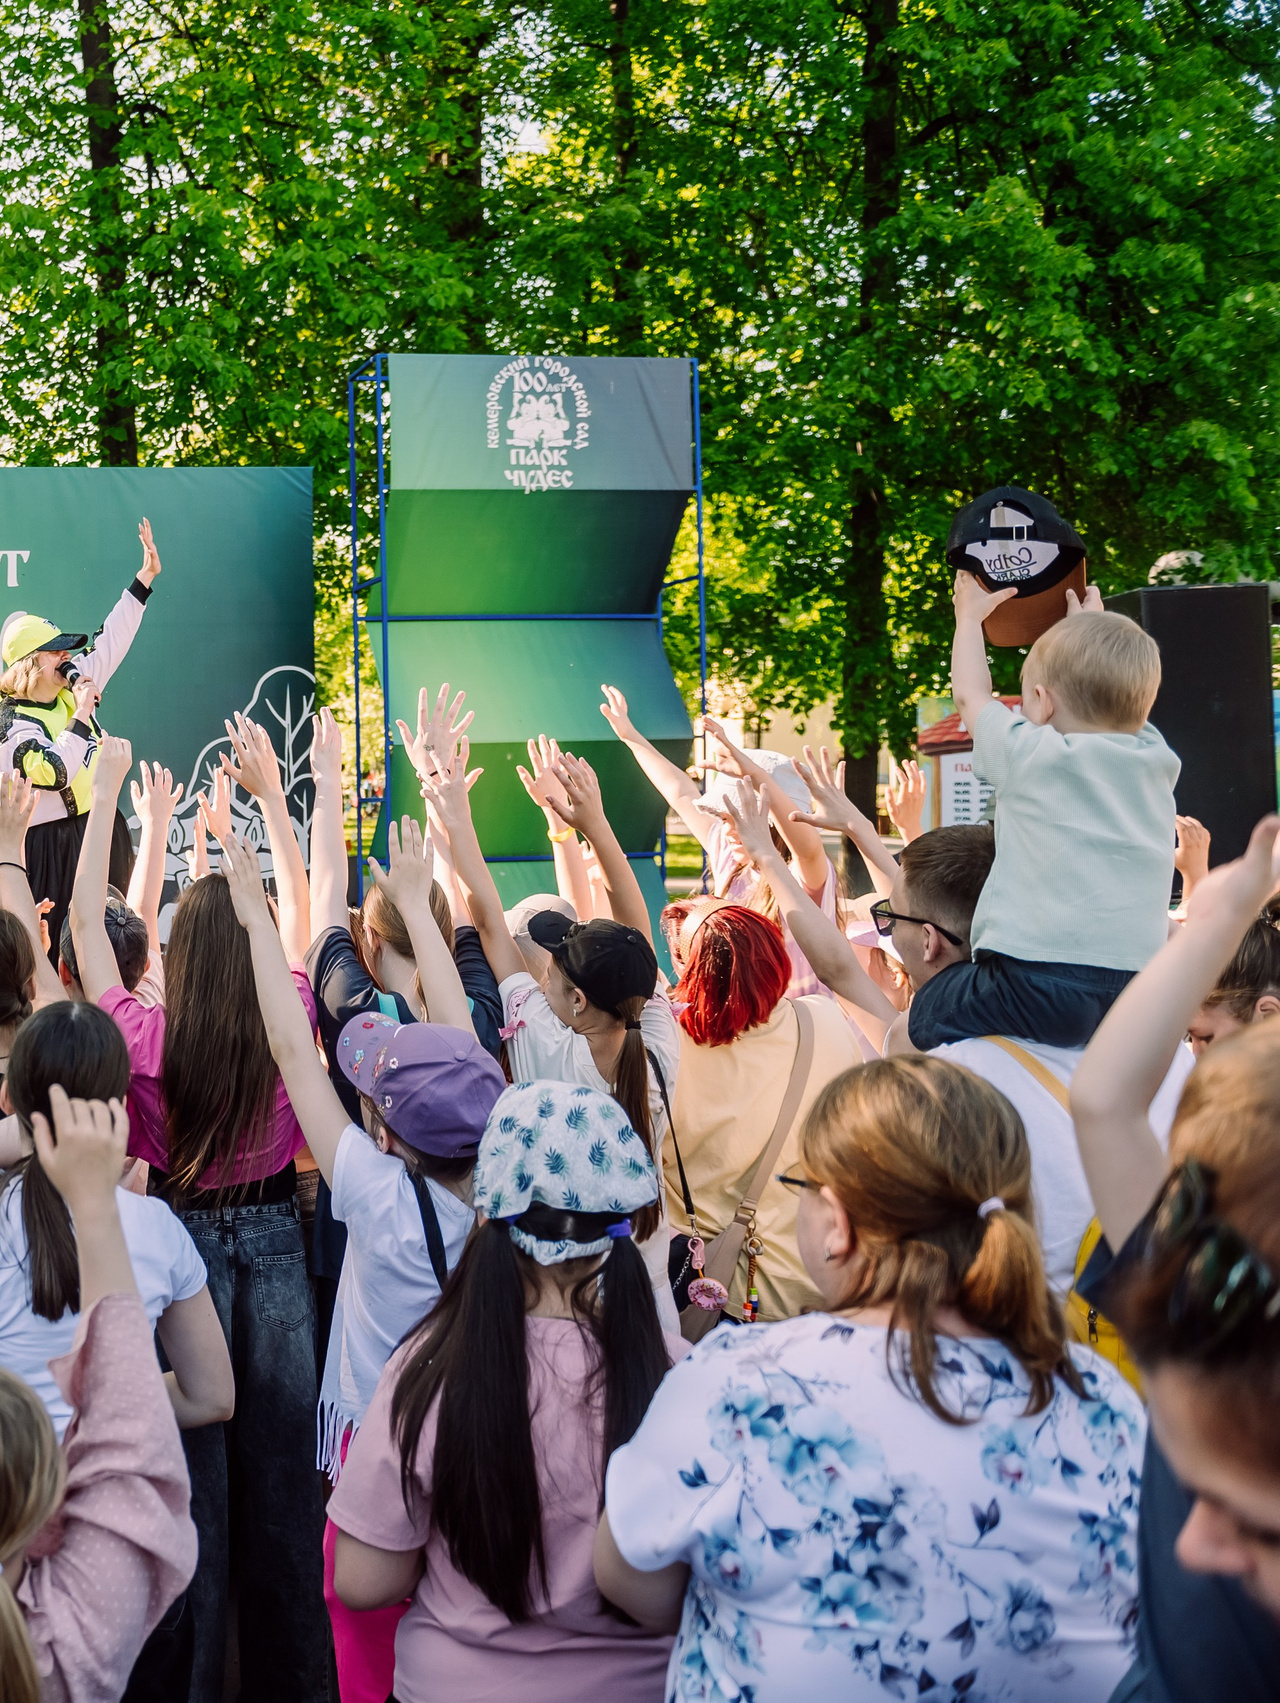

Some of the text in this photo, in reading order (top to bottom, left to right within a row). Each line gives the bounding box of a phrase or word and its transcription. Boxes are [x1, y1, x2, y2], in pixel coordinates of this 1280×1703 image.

[512, 370, 568, 393] 100 ЛЕТ
[485, 355, 592, 450] КЕМЕРОВСКИЙ ГОРОДСКОЙ САД
[509, 448, 568, 474] ПАРК
[503, 469, 574, 495] ЧУДЕС
